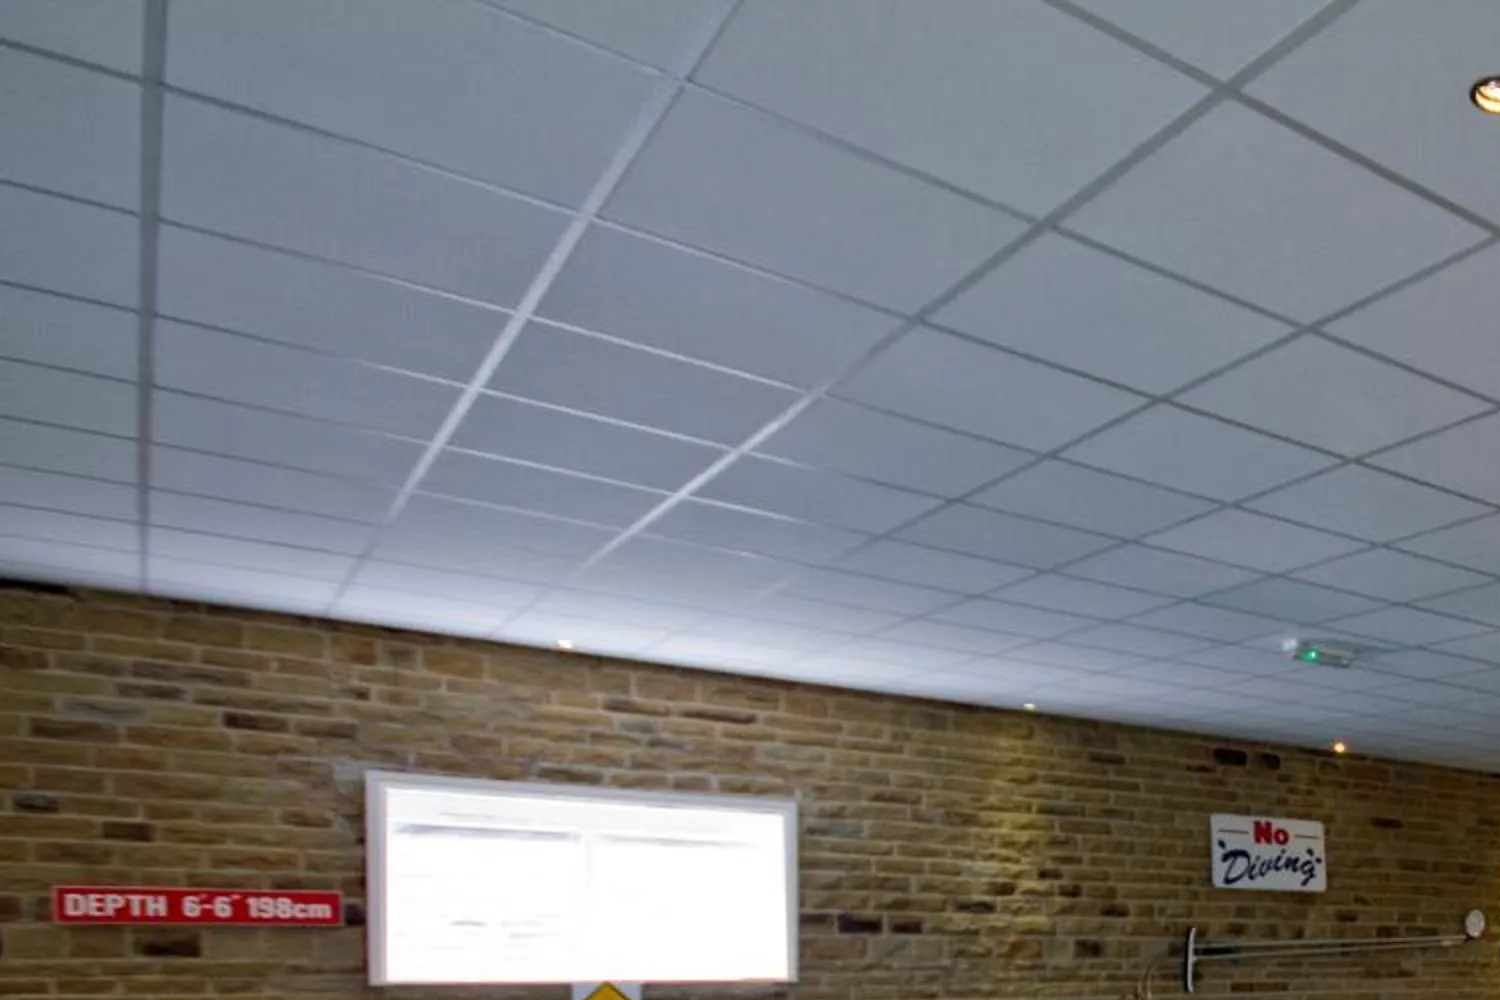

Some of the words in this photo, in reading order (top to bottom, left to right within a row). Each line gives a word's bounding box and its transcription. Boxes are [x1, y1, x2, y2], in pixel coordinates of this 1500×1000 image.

[1253, 821, 1289, 845] No
[1221, 847, 1320, 886] Diving
[64, 893, 168, 917] DEPTH
[245, 896, 333, 919] 198cm
